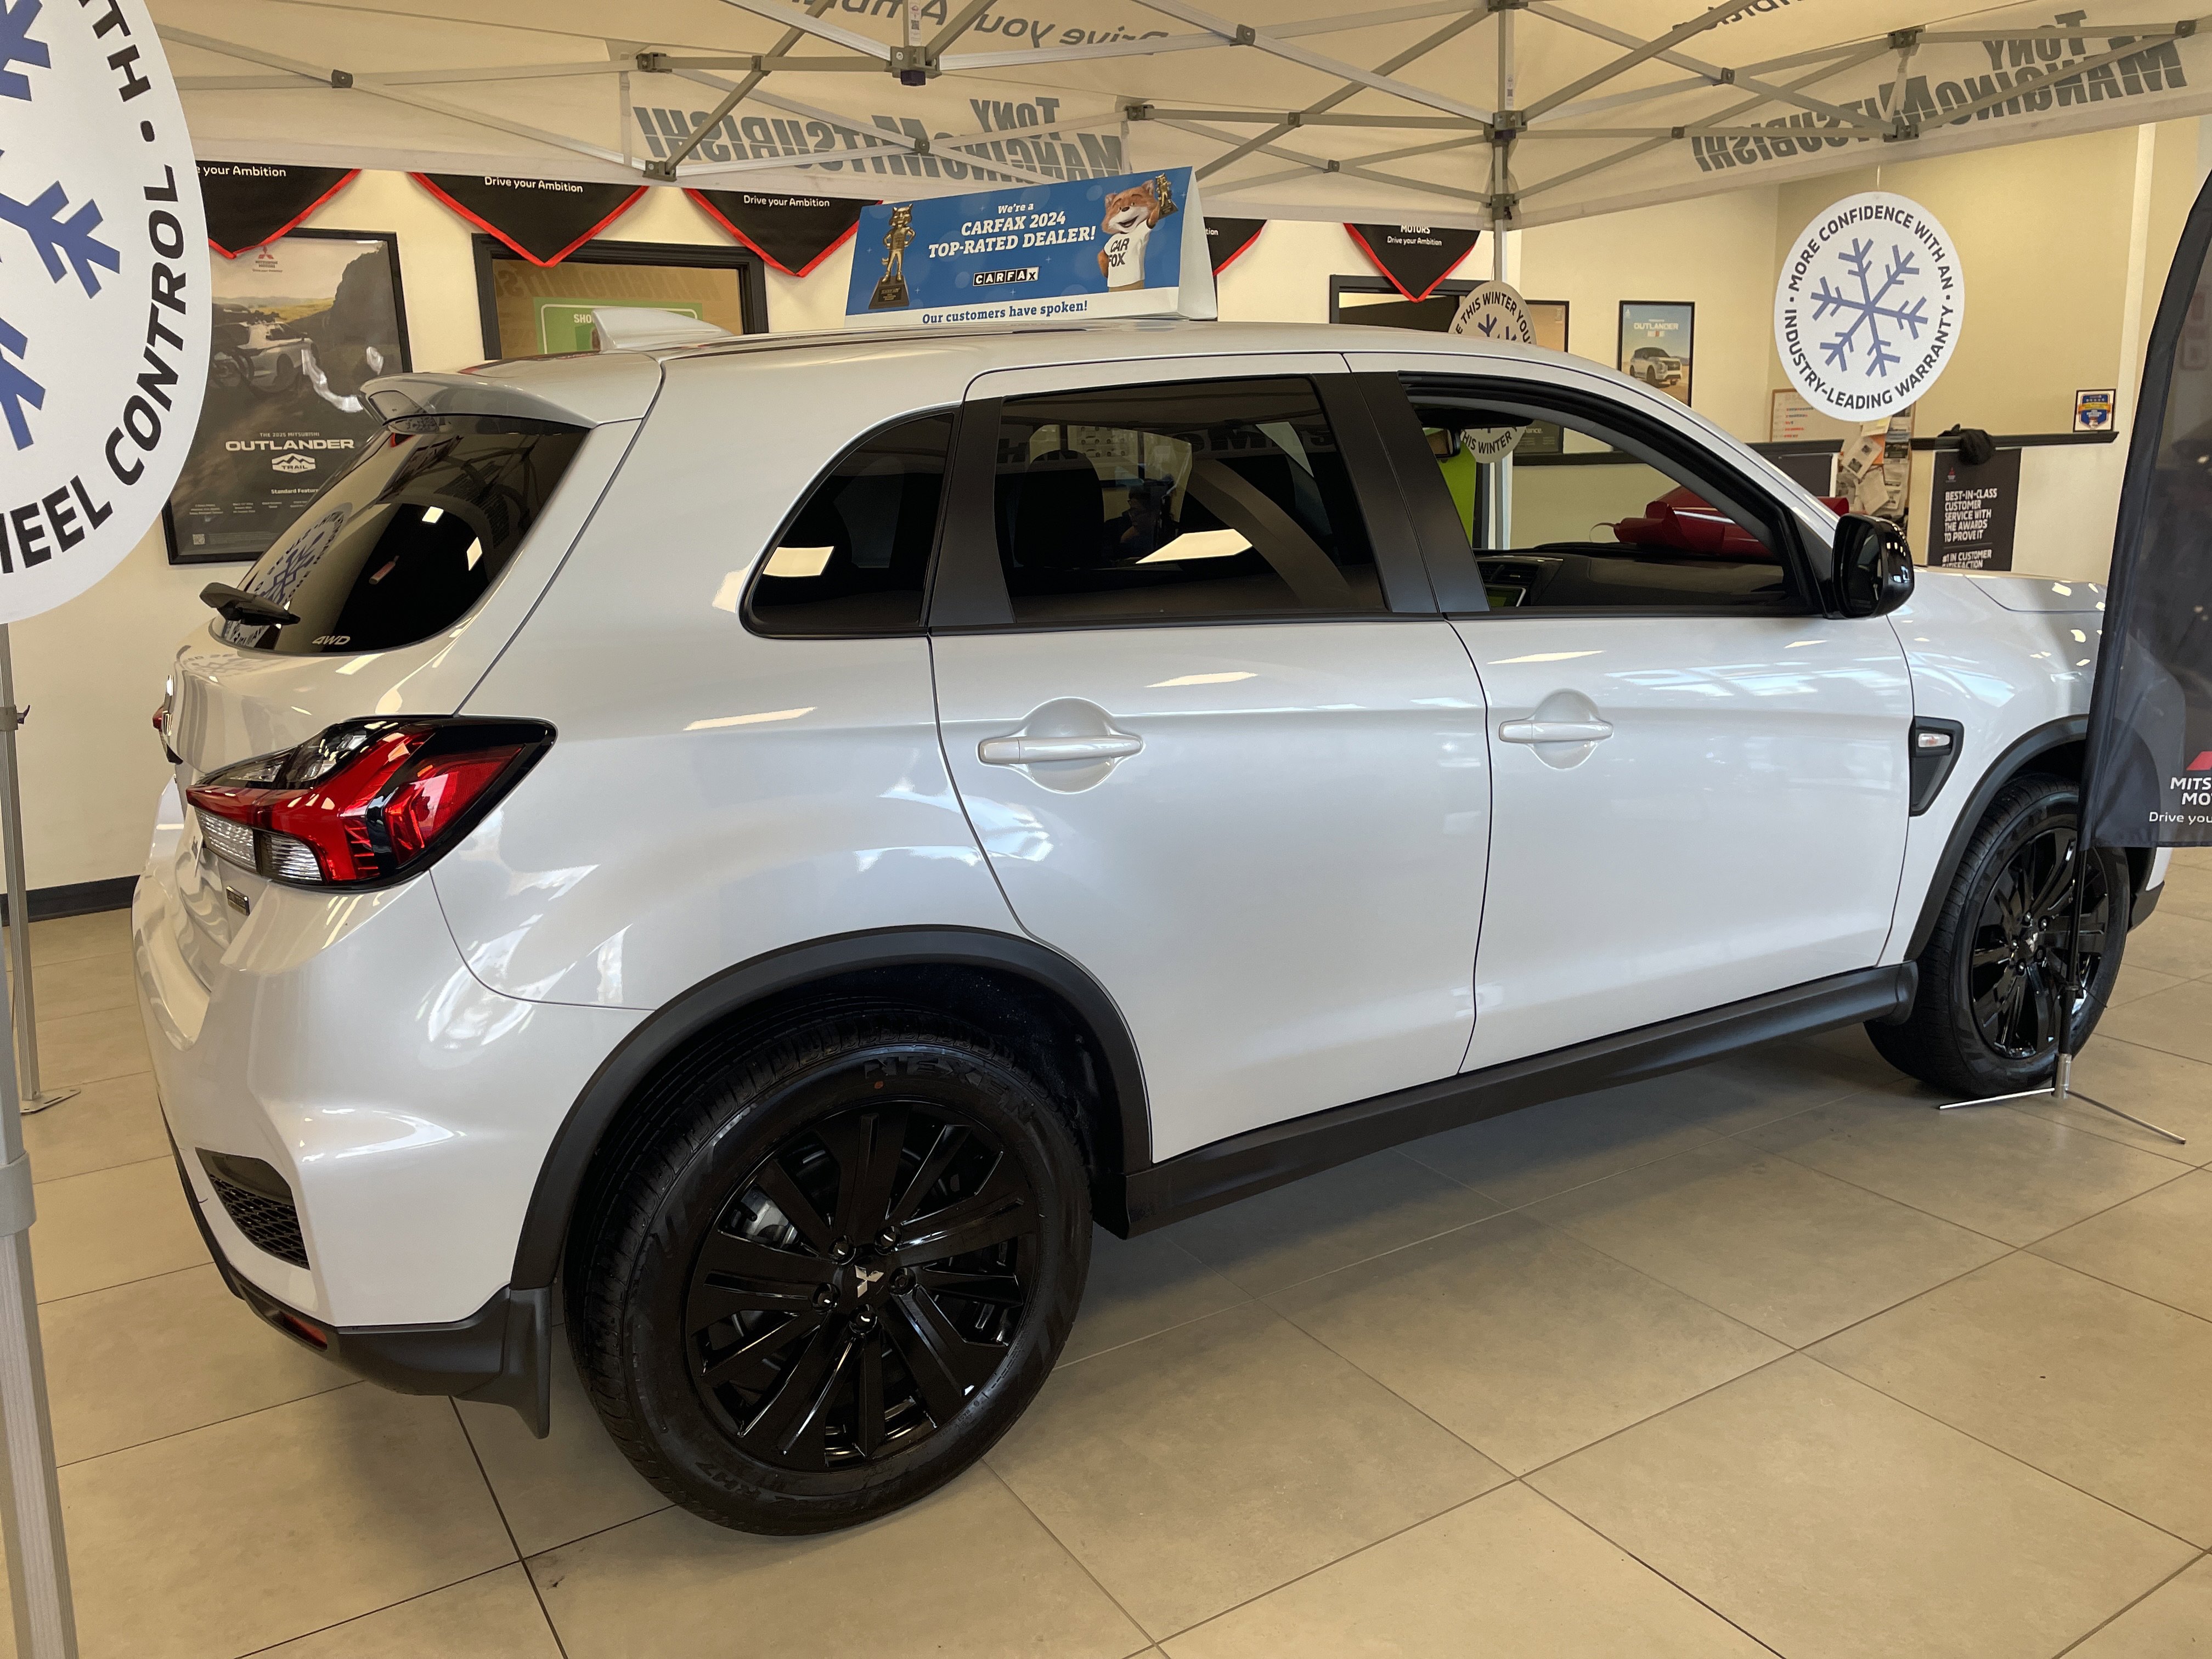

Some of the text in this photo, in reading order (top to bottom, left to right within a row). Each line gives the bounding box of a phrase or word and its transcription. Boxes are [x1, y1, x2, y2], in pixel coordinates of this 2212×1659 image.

[204, 167, 230, 177] your
[233, 166, 286, 177] Ambition
[484, 176, 583, 193] Drive your Ambition
[743, 194, 830, 207] Drive your Ambition
[998, 204, 1026, 214] We're
[961, 211, 1066, 236] CARFAX 2024
[1401, 225, 1431, 234] MOTORS
[928, 225, 1096, 258] TOP-RATED DEALER!
[1110, 238, 1130, 253] CAR
[1417, 237, 1442, 246] Ambition
[1788, 205, 1954, 292] MORE CONFIDENCE WITH AN
[1109, 252, 1126, 268] FOX
[974, 268, 1038, 285] CARFAX
[922, 300, 1088, 324] Our customers have spoken!
[1460, 297, 1481, 325] THIS
[1482, 291, 1517, 316] WINTER
[1516, 309, 1532, 345] YOU
[105, 164, 186, 486] CONTROL
[1785, 304, 1954, 409] INDUSTRY-LEADING WARRANTY
[225, 439, 356, 451] OUTLANDER
[1479, 431, 1513, 454] WINTER
[1946, 488, 1997, 500] BEST-IN-CLASS
[1945, 501, 1981, 511] CUSTOMER
[1945, 509, 1992, 522] SERVICE WITH
[1945, 519, 1988, 532] THE AWARDS
[1944, 533, 1951, 543] TO
[1953, 531, 1976, 542] PROVE
[1950, 552, 1957, 562] IN
[1958, 549, 1992, 561] CUSTOMER
[312, 636, 351, 645] 4WD
[2149, 811, 2185, 823] Drive
[864, 1056, 1037, 1125] NEXEN
